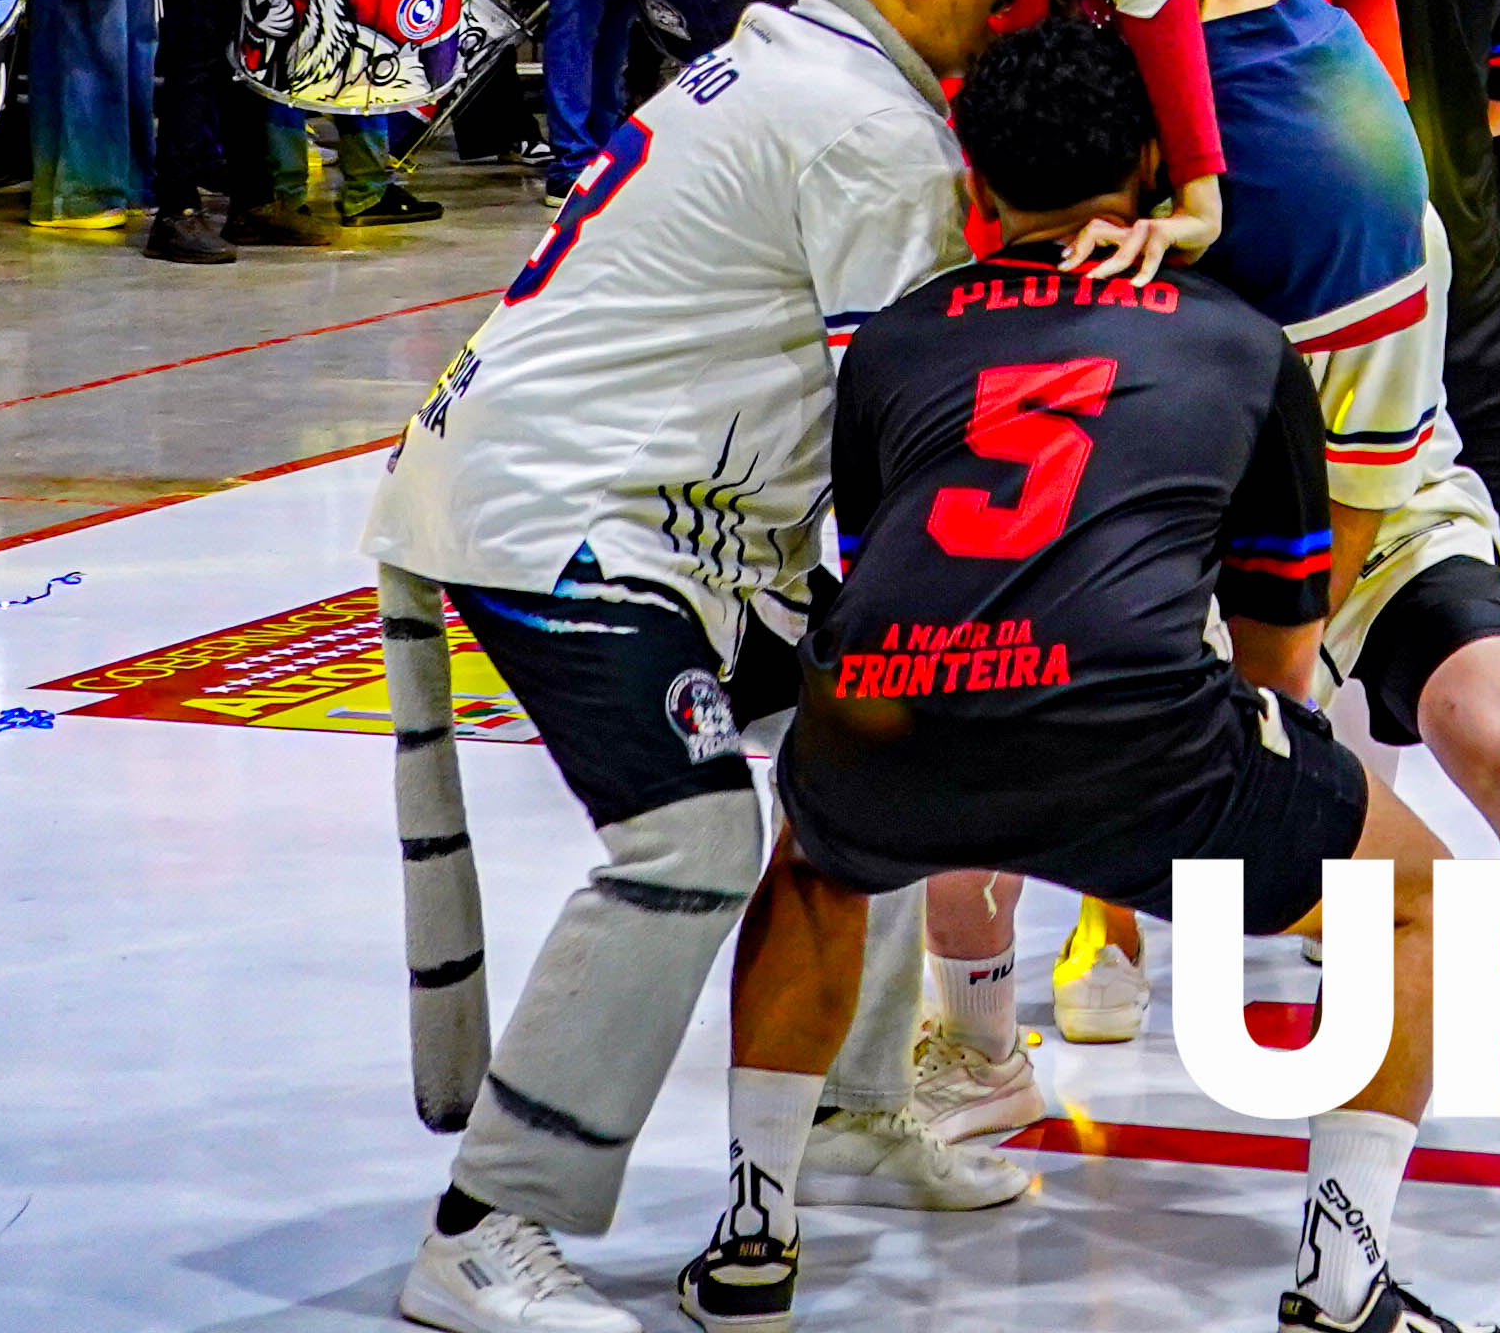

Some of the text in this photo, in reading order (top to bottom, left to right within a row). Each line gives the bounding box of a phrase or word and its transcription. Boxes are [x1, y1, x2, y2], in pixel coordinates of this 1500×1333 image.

[881, 623, 900, 650] A
[995, 618, 1033, 646] DA
[180, 660, 386, 719] ALTO
[835, 644, 1071, 699] FRONTEIRA
